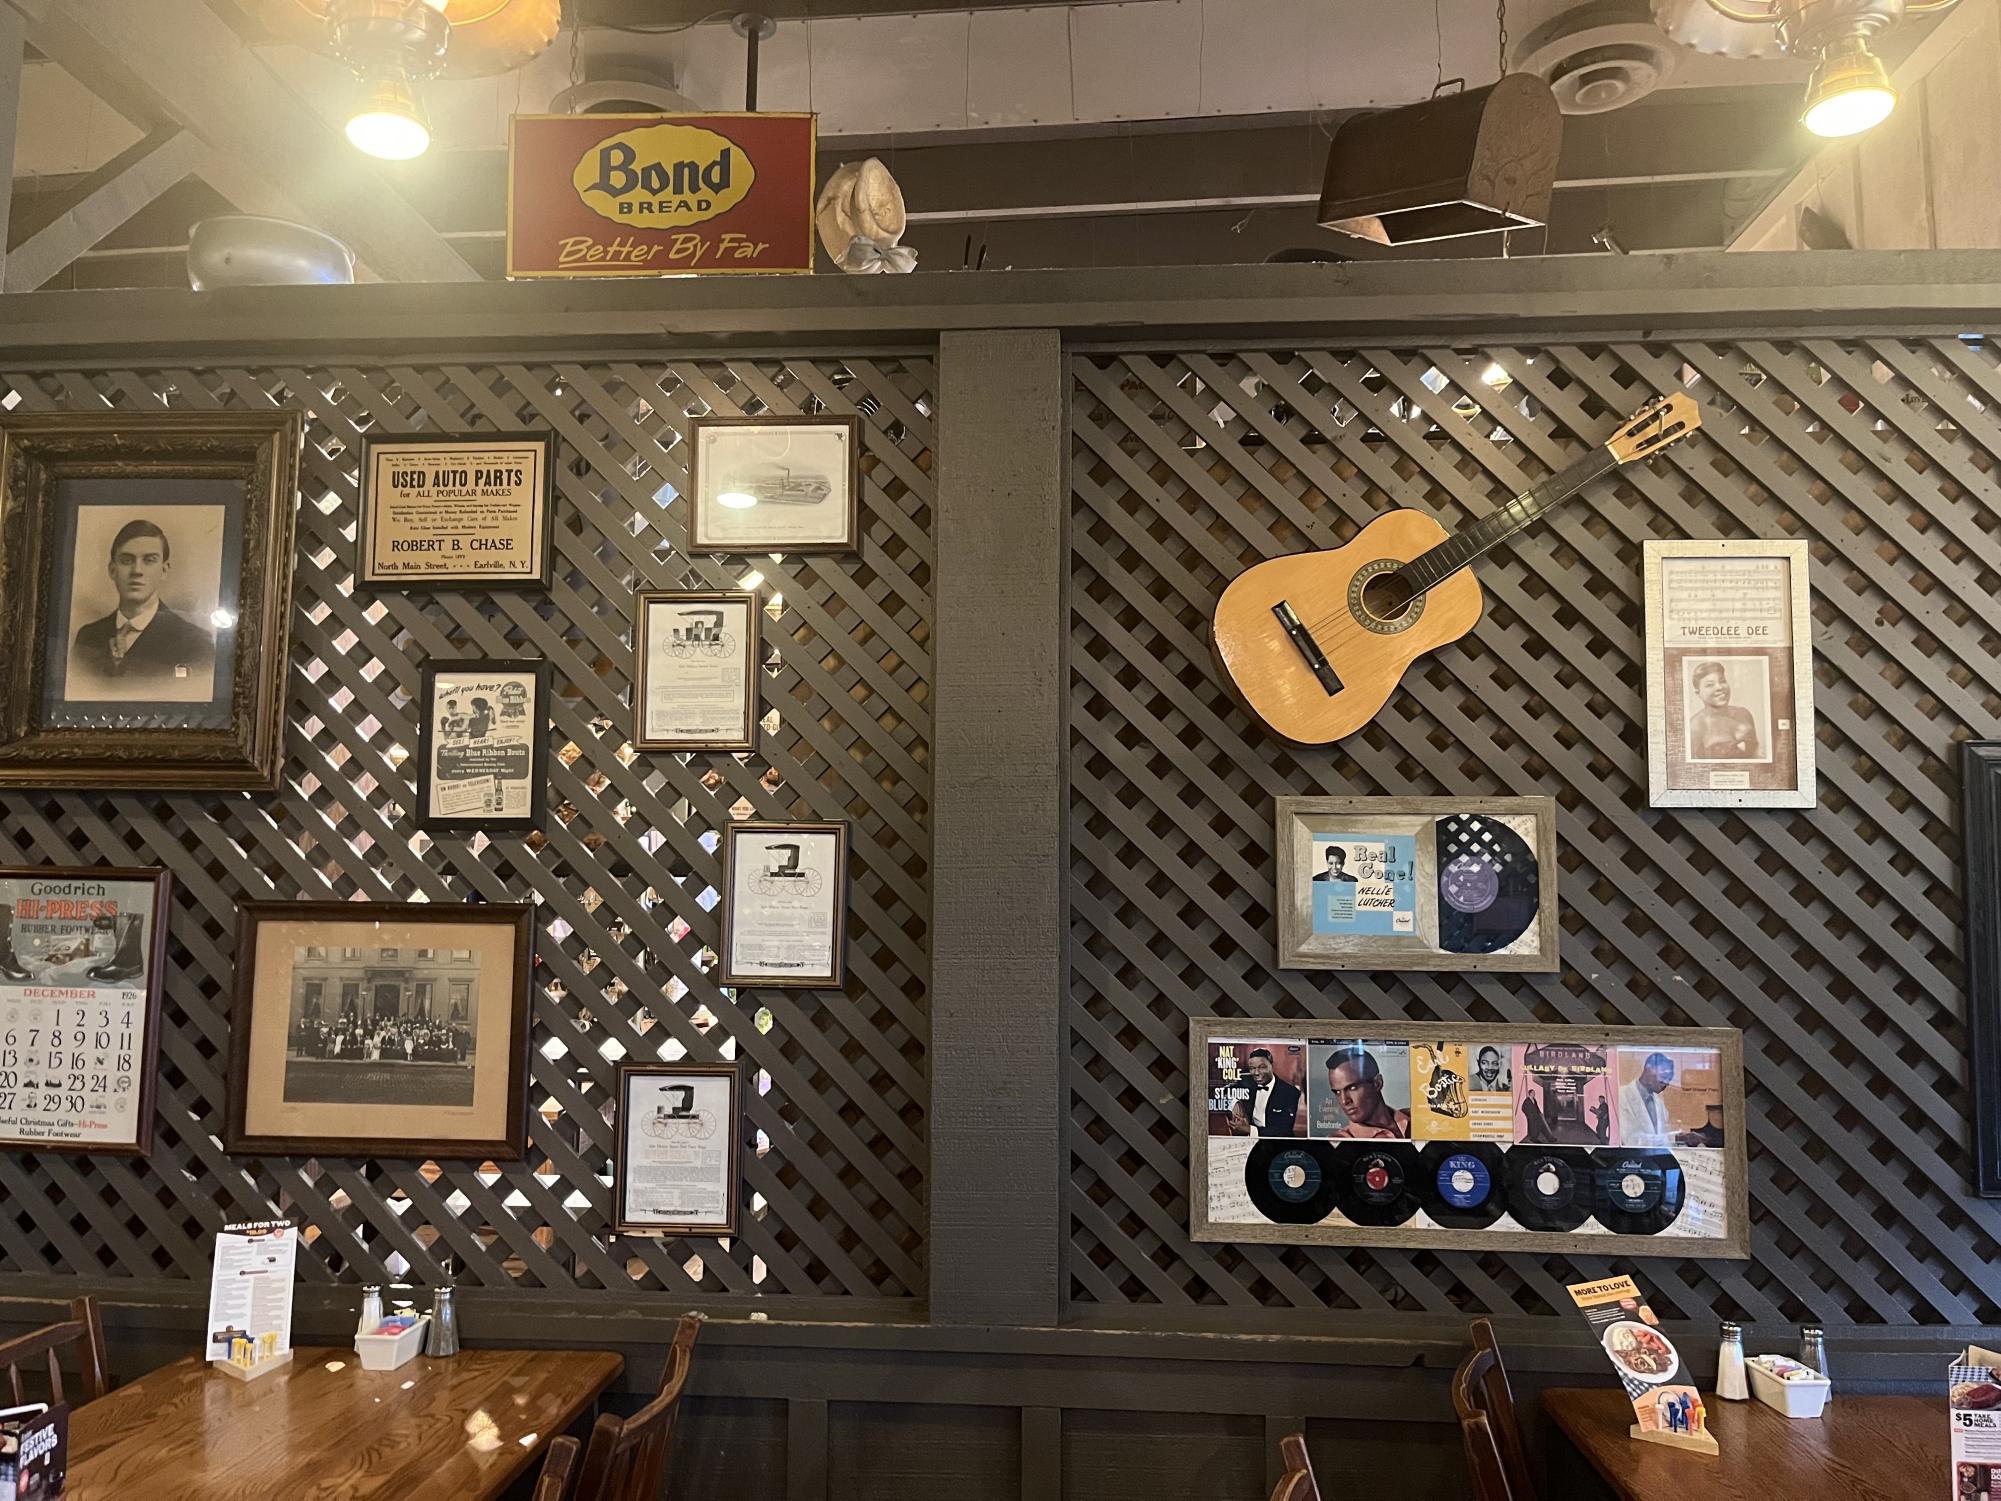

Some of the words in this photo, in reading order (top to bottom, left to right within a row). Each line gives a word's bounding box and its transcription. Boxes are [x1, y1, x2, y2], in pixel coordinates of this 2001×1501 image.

[584, 142, 730, 198] Bond
[618, 199, 712, 215] BREAD
[558, 236, 663, 263] Better
[668, 233, 710, 267] By
[715, 233, 770, 259] Far
[391, 470, 426, 489] USED
[432, 469, 468, 488] AUTO
[474, 468, 523, 487] PARTS
[399, 489, 411, 498] for
[415, 489, 433, 498] ALL
[436, 488, 477, 497] POPULAR
[481, 488, 512, 497] MAKES
[391, 539, 445, 552] ROBERT
[452, 539, 463, 551] B.
[470, 538, 514, 551] CHASE
[378, 562, 399, 571] North
[402, 562, 421, 570] Main
[424, 562, 449, 571] Street,
[509, 560, 518, 569] N.
[520, 560, 529, 569] Y.
[1681, 626, 1740, 636] TWEEDLEE
[1746, 626, 1768, 636] DEE
[475, 683, 502, 692] have?
[466, 748, 481, 756] Blue
[482, 748, 506, 756] Ribbon
[1353, 844, 1396, 863] Real
[1358, 860, 1414, 881] Gone!
[30, 882, 106, 896] Goodrich
[1358, 885, 1393, 896] NELLIE
[15, 898, 119, 920] HI-PRESS
[1358, 898, 1396, 908] LUTCHER
[20, 924, 57, 934] RUBBER
[23, 988, 97, 999] DECEMBER
[121, 991, 138, 1000] 1926
[56, 1008, 60, 1026] 1
[76, 1009, 86, 1028] 2
[98, 1009, 110, 1028] 3
[120, 1010, 133, 1029] 4
[5, 1028, 17, 1046] 6
[28, 1028, 40, 1047] 7
[50, 1029, 62, 1048] 8
[74, 1030, 86, 1049] 9
[94, 1031, 111, 1050] 10
[120, 1032, 132, 1050] 11
[1219, 1046, 1235, 1057] NAT
[1539, 1050, 1591, 1060] BIRDLAND
[2, 1048, 18, 1068] 13
[48, 1050, 63, 1070] 15
[71, 1052, 86, 1070] 16
[116, 1053, 132, 1072] 18
[1222, 1068, 1243, 1080] COLE
[1572, 1065, 1612, 1074] BIRDLAND
[0, 1070, 18, 1089] 20
[67, 1073, 86, 1092] 23
[90, 1074, 108, 1092] 24
[1420, 1074, 1460, 1100] Bostic
[1214, 1087, 1226, 1100] ST.
[1227, 1088, 1250, 1100] LOUIS
[0, 1092, 17, 1110] 27
[42, 1094, 62, 1112] 29
[64, 1094, 85, 1114] 30
[20, 1117, 55, 1127] Christmas
[19, 1128, 45, 1137] Rubber
[47, 1128, 82, 1138] Footwear
[1449, 1160, 1476, 1169] KING
[224, 1222, 253, 1231] MEALS
[253, 1221, 270, 1229] FOR
[270, 1220, 292, 1228] TWO
[1574, 1286, 1598, 1296] MORE
[1597, 1284, 1609, 1292] TO
[1608, 1280, 1632, 1290] LOVE
[1955, 1412, 1974, 1428] $5
